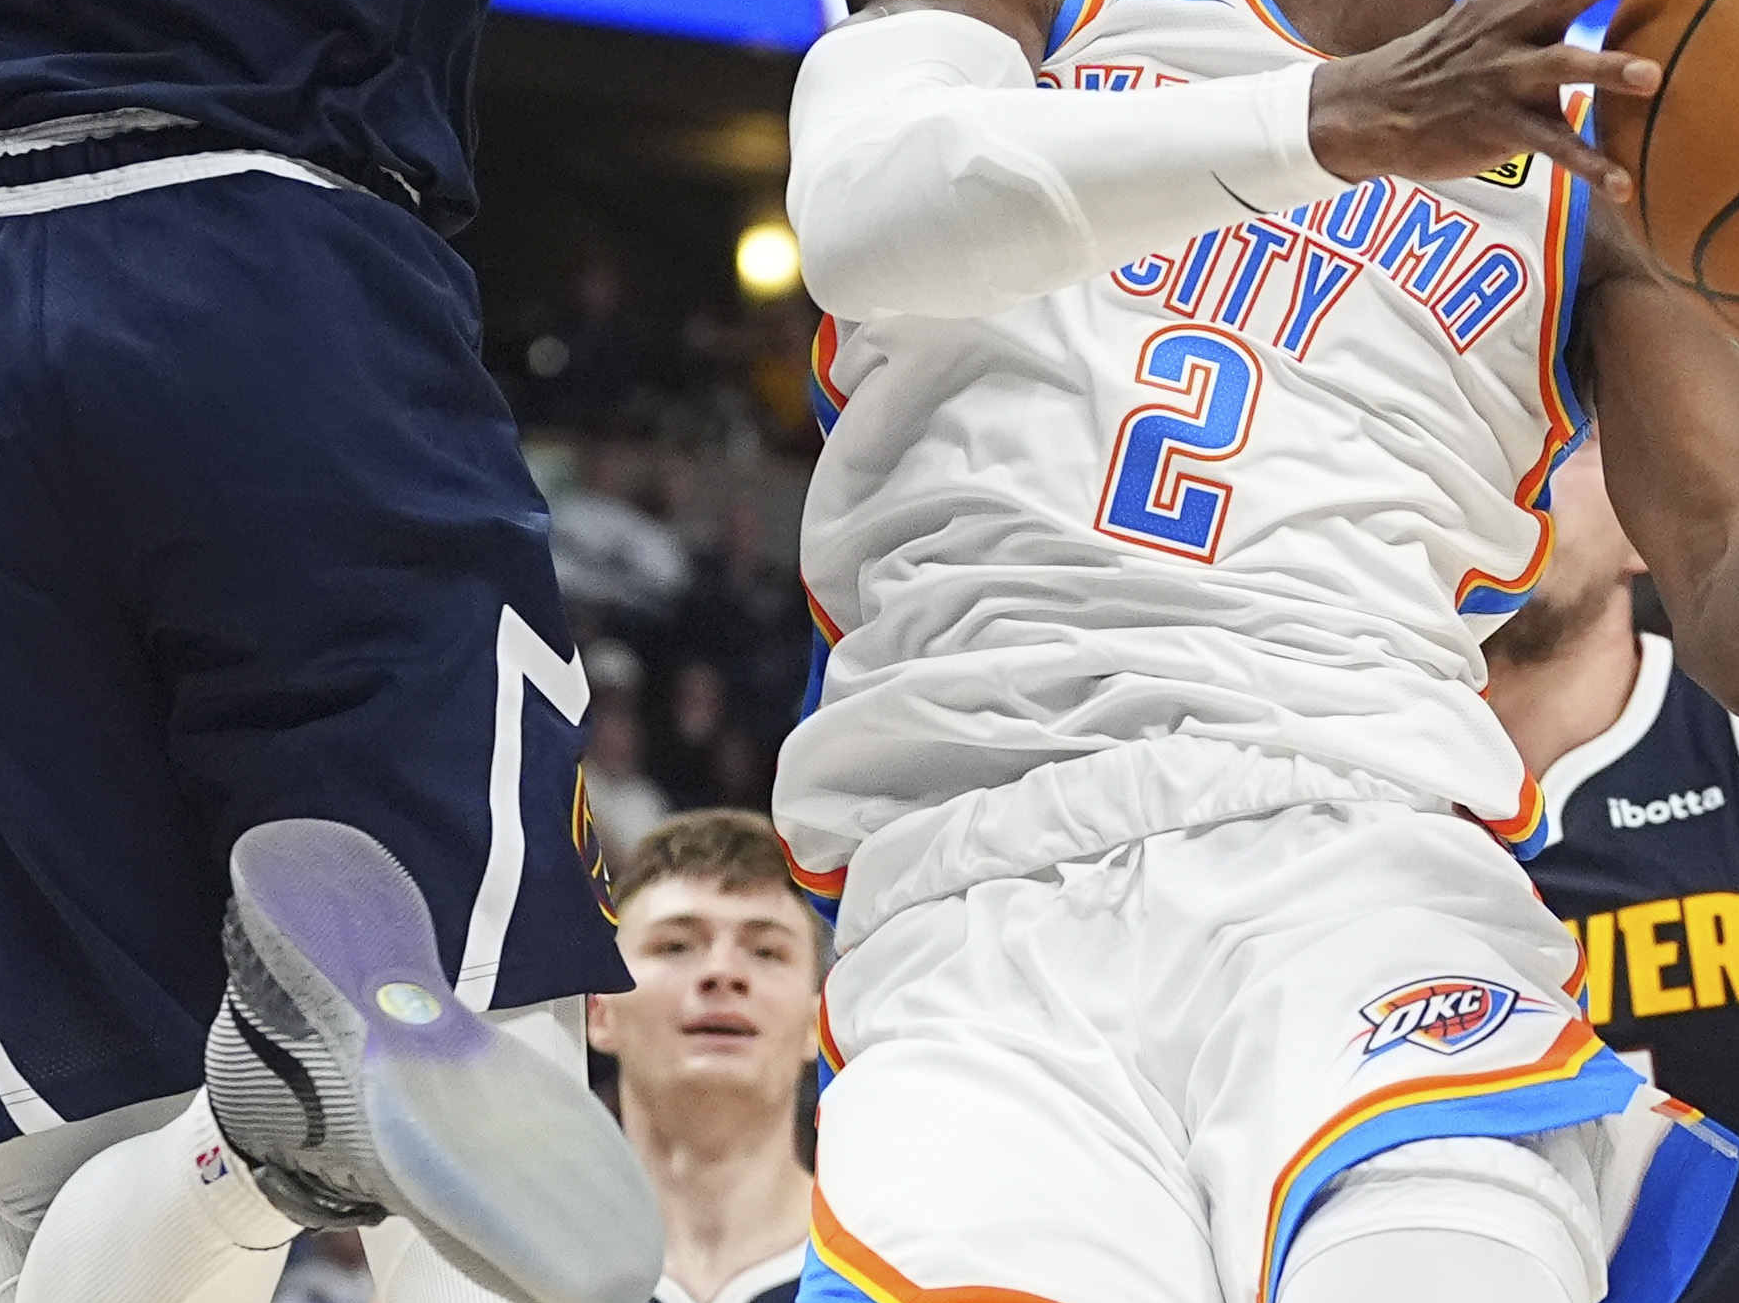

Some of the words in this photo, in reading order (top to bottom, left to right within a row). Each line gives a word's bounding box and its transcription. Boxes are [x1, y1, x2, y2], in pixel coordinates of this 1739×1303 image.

[1093, 323, 1262, 565] 2
[1606, 785, 1726, 830] ibotta
[1362, 988, 1484, 1056] OKC
